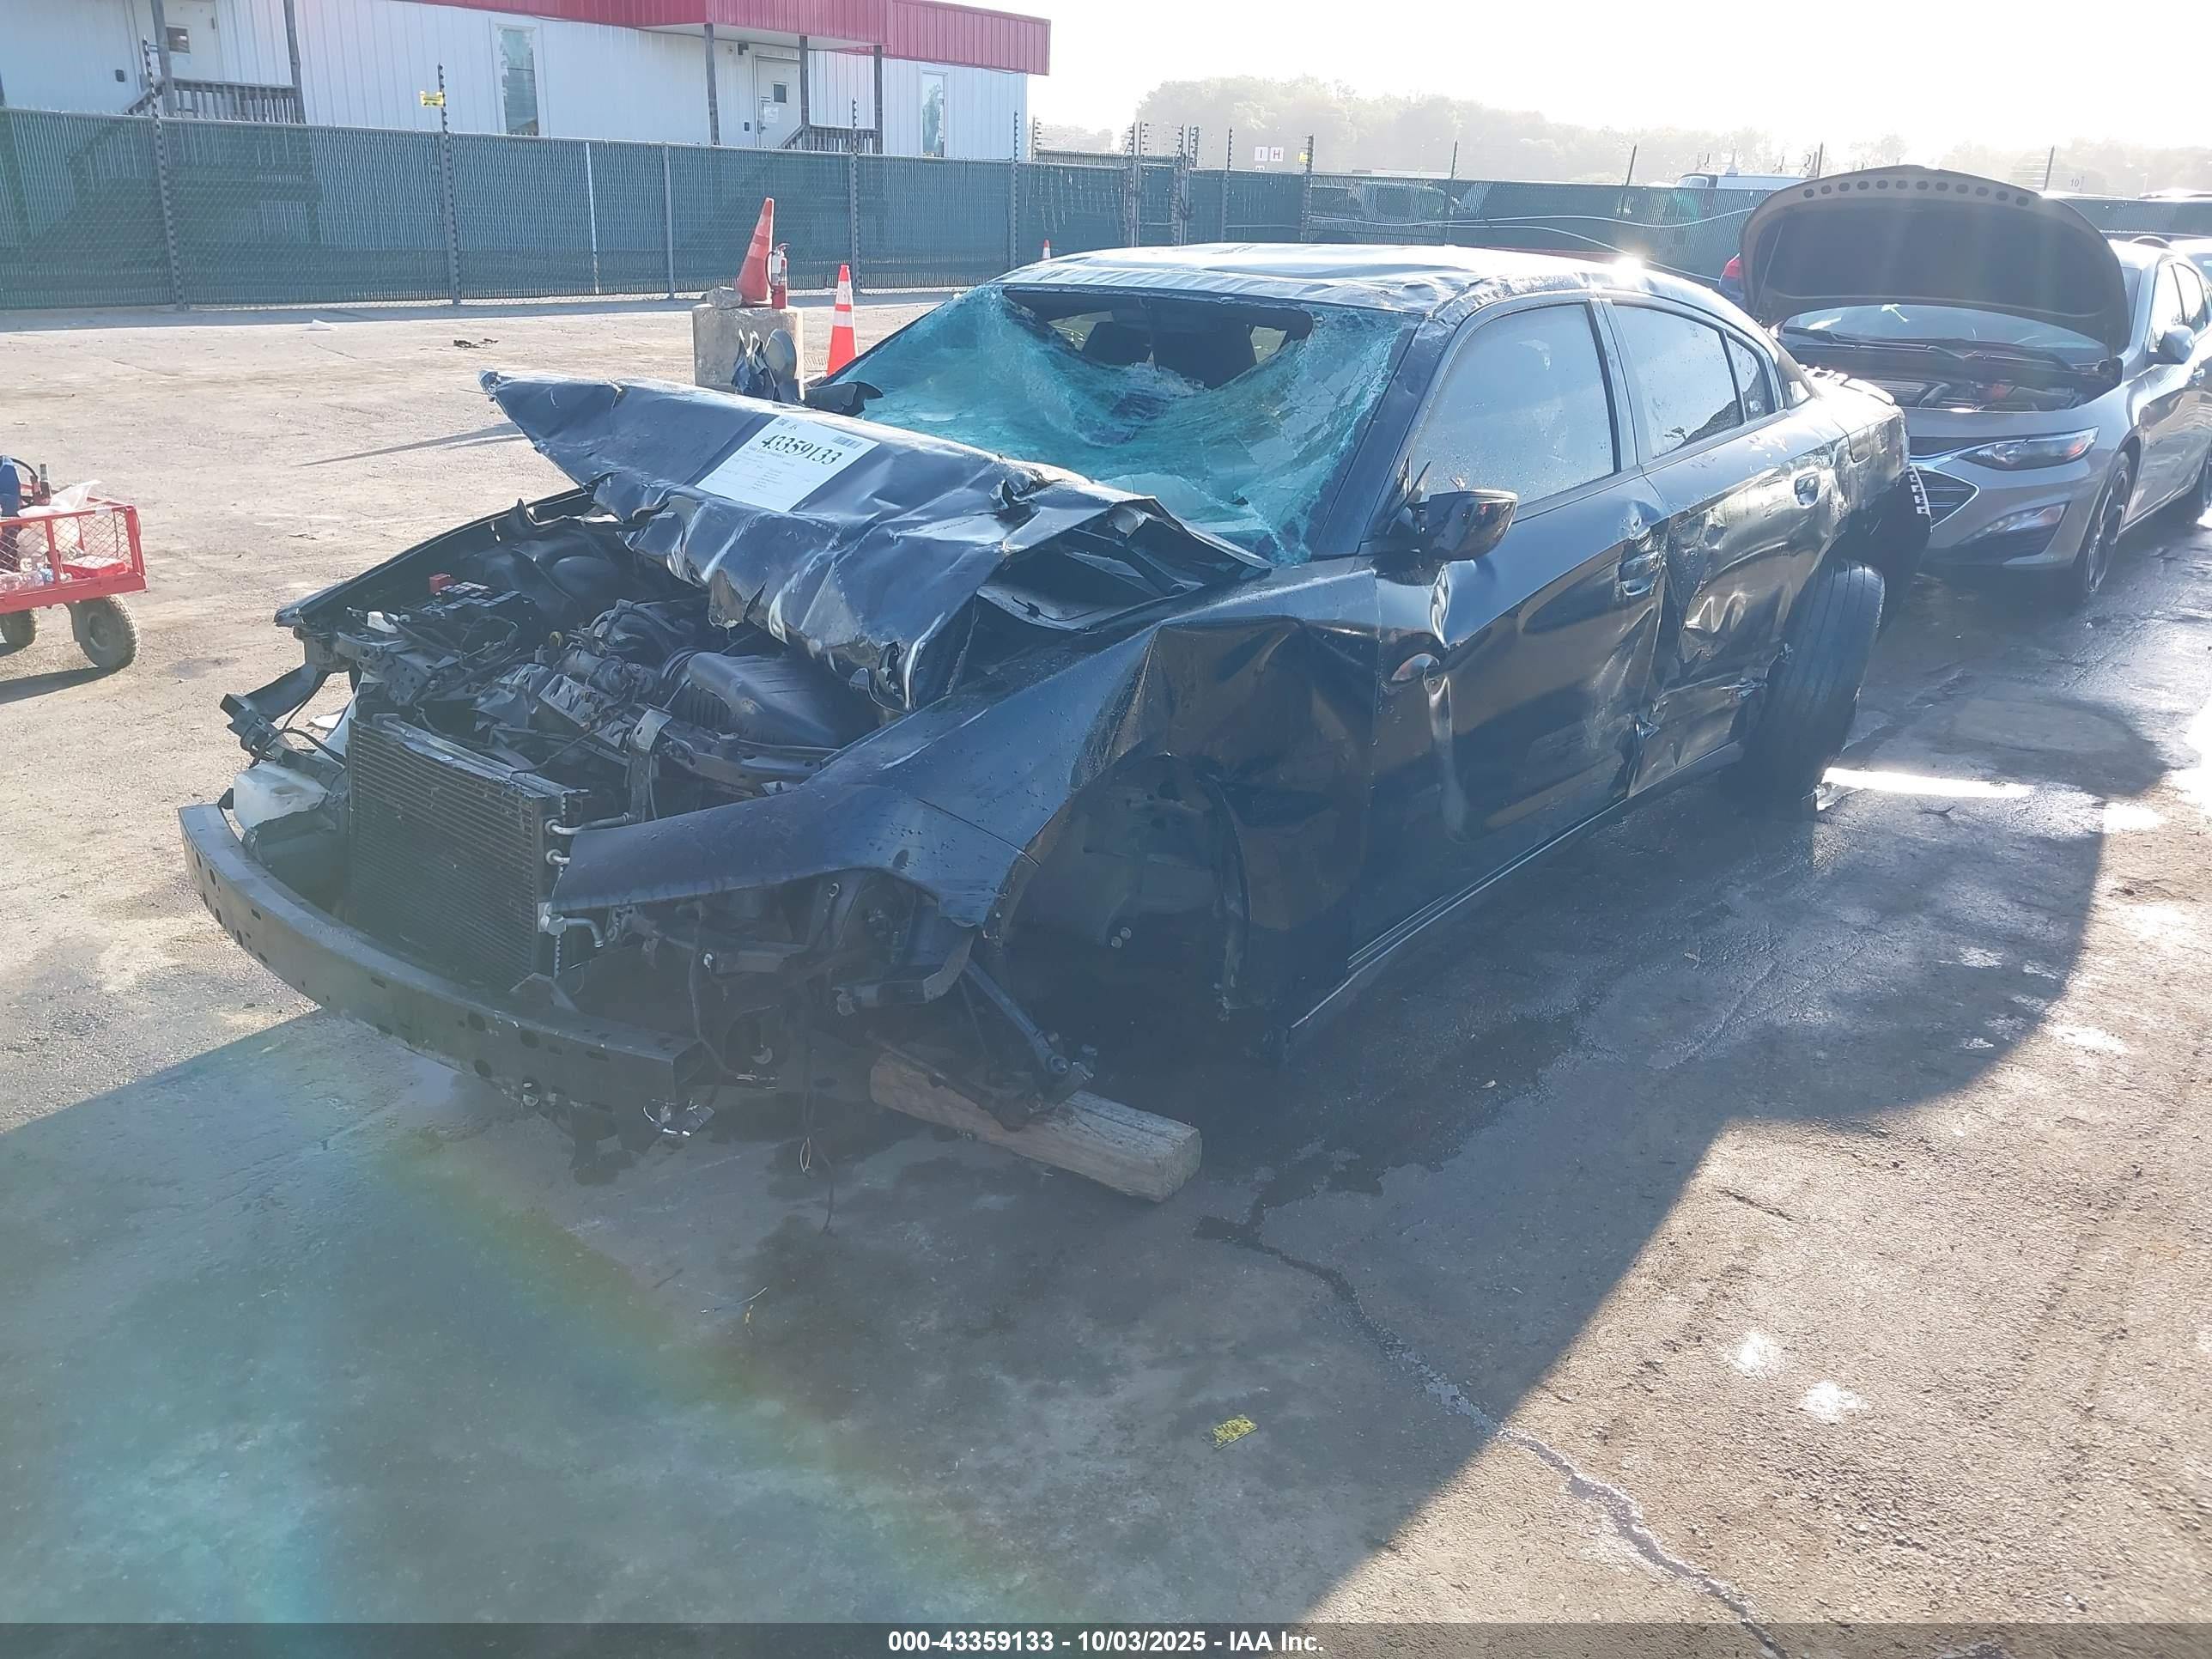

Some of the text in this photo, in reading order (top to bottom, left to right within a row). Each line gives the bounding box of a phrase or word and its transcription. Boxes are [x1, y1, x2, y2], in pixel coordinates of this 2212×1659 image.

[1273, 149, 1281, 160] H
[2070, 178, 2080, 187] 10
[761, 434, 842, 465] 43359133
